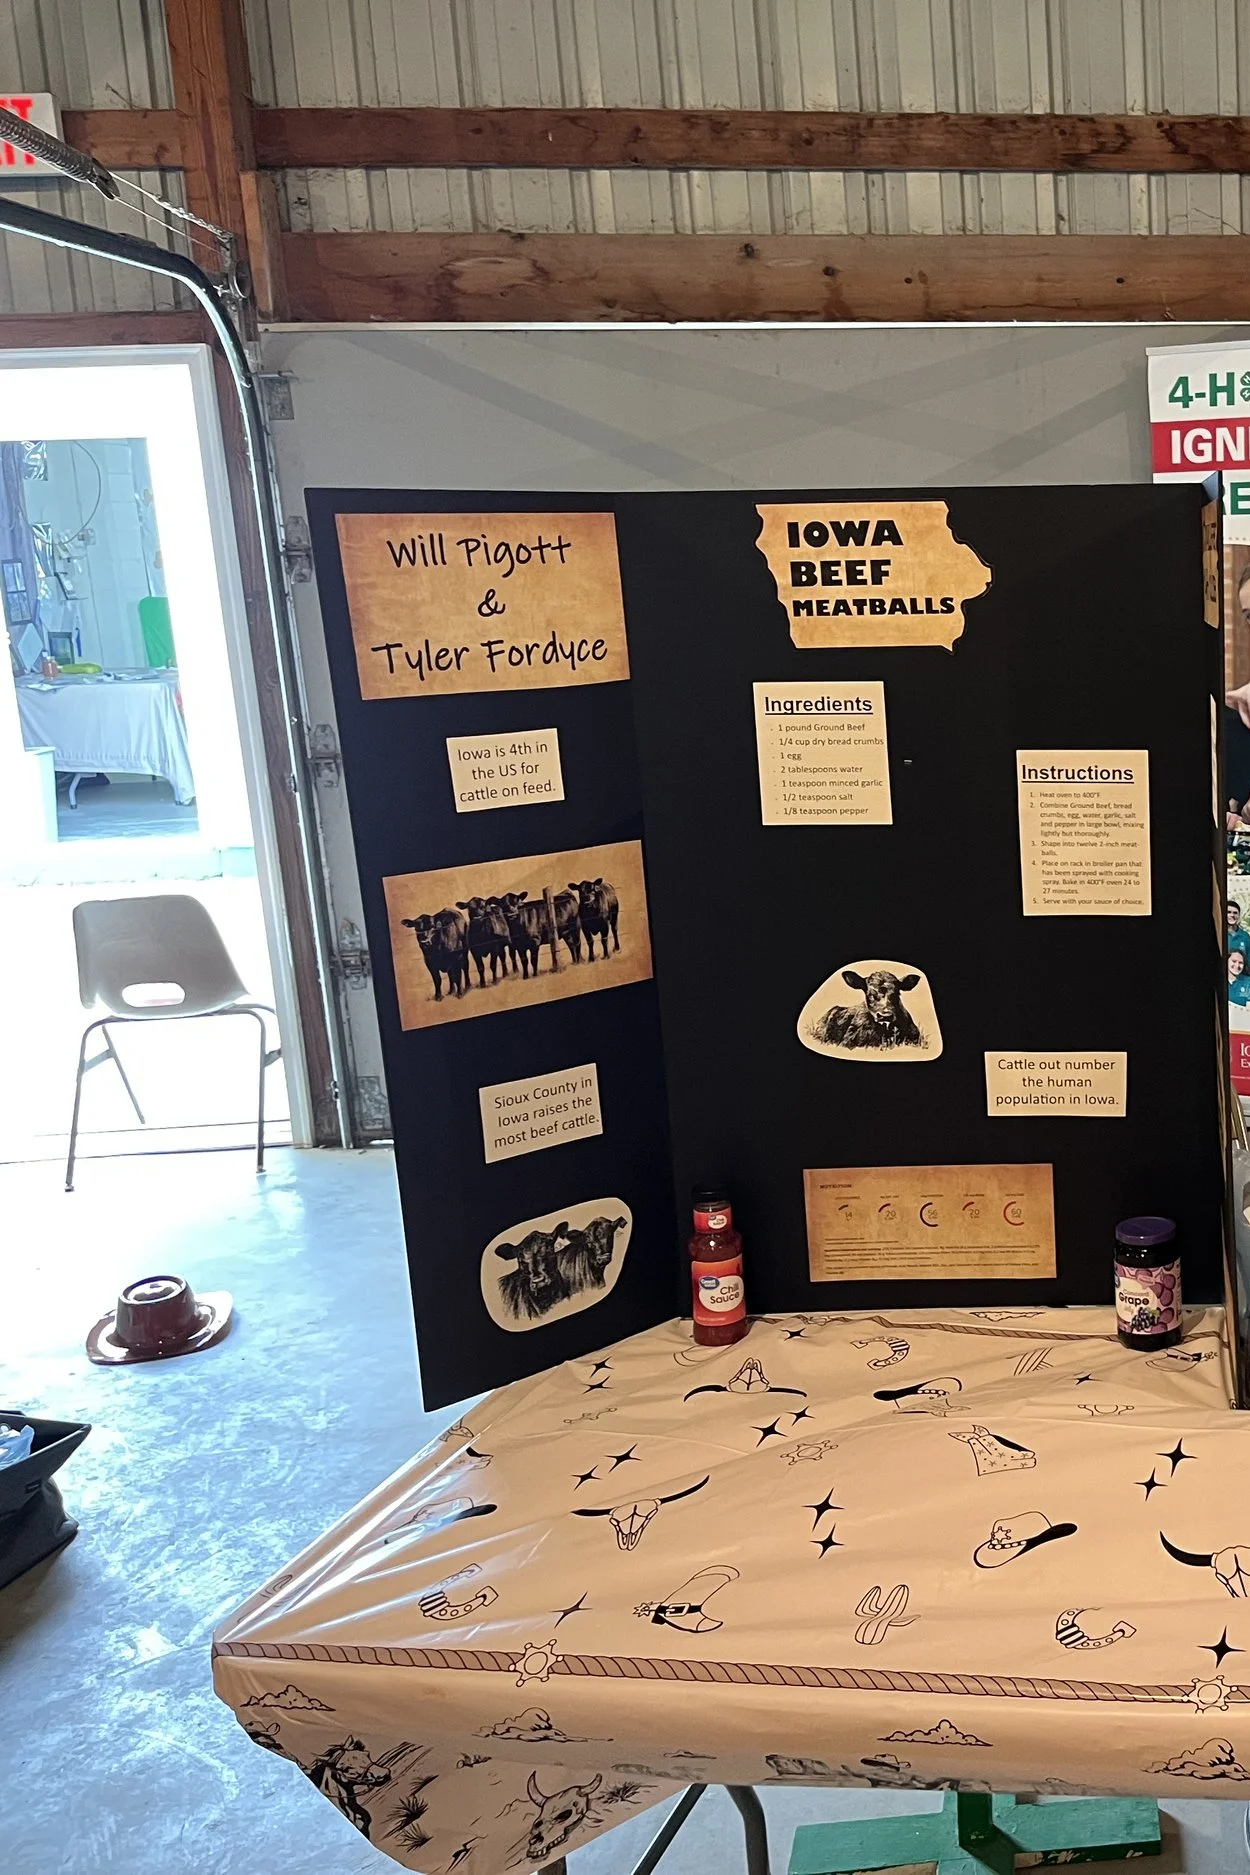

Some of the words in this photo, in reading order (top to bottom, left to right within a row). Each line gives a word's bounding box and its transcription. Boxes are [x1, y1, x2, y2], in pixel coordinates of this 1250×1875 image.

[1168, 372, 1235, 408] 4-H
[787, 520, 903, 548] IOWA
[386, 533, 446, 568] Will
[456, 534, 572, 578] Pigott
[790, 559, 891, 587] BEEF
[478, 588, 505, 617] &
[792, 597, 955, 617] MEATBALLS
[371, 639, 469, 681] Tyler
[481, 631, 608, 672] Fordyce
[765, 696, 872, 713] Ingredients
[786, 724, 811, 732] pound
[458, 749, 490, 761] Iowa
[495, 746, 505, 757] is
[510, 742, 531, 755] 4th
[536, 742, 548, 753] in
[779, 738, 793, 746] 1/4
[812, 738, 825, 746] dry
[472, 767, 494, 779] the
[499, 764, 517, 777] US
[521, 762, 539, 774] for
[1022, 765, 1133, 780] Instructions
[460, 787, 497, 802] cattle
[502, 787, 518, 797] on
[523, 780, 556, 794] feed.
[998, 1059, 1035, 1070] Cattle
[1039, 1060, 1061, 1070] out
[1065, 1059, 1115, 1070] number
[1022, 1077, 1043, 1087] the
[1047, 1077, 1092, 1087] human
[495, 1093, 529, 1109] Sioux
[533, 1082, 577, 1099] County
[581, 1077, 592, 1088] in
[997, 1094, 1065, 1106] population
[1070, 1094, 1080, 1104] in
[1085, 1095, 1118, 1105] Iowa.
[498, 1112, 529, 1127] Iowa
[534, 1103, 568, 1119] raises
[573, 1097, 592, 1109] the
[494, 1131, 526, 1148] most
[531, 1121, 558, 1138] beef
[562, 1113, 599, 1130] cattle.
[710, 1292, 739, 1304] Sauce
[1119, 1292, 1149, 1306] Grape
